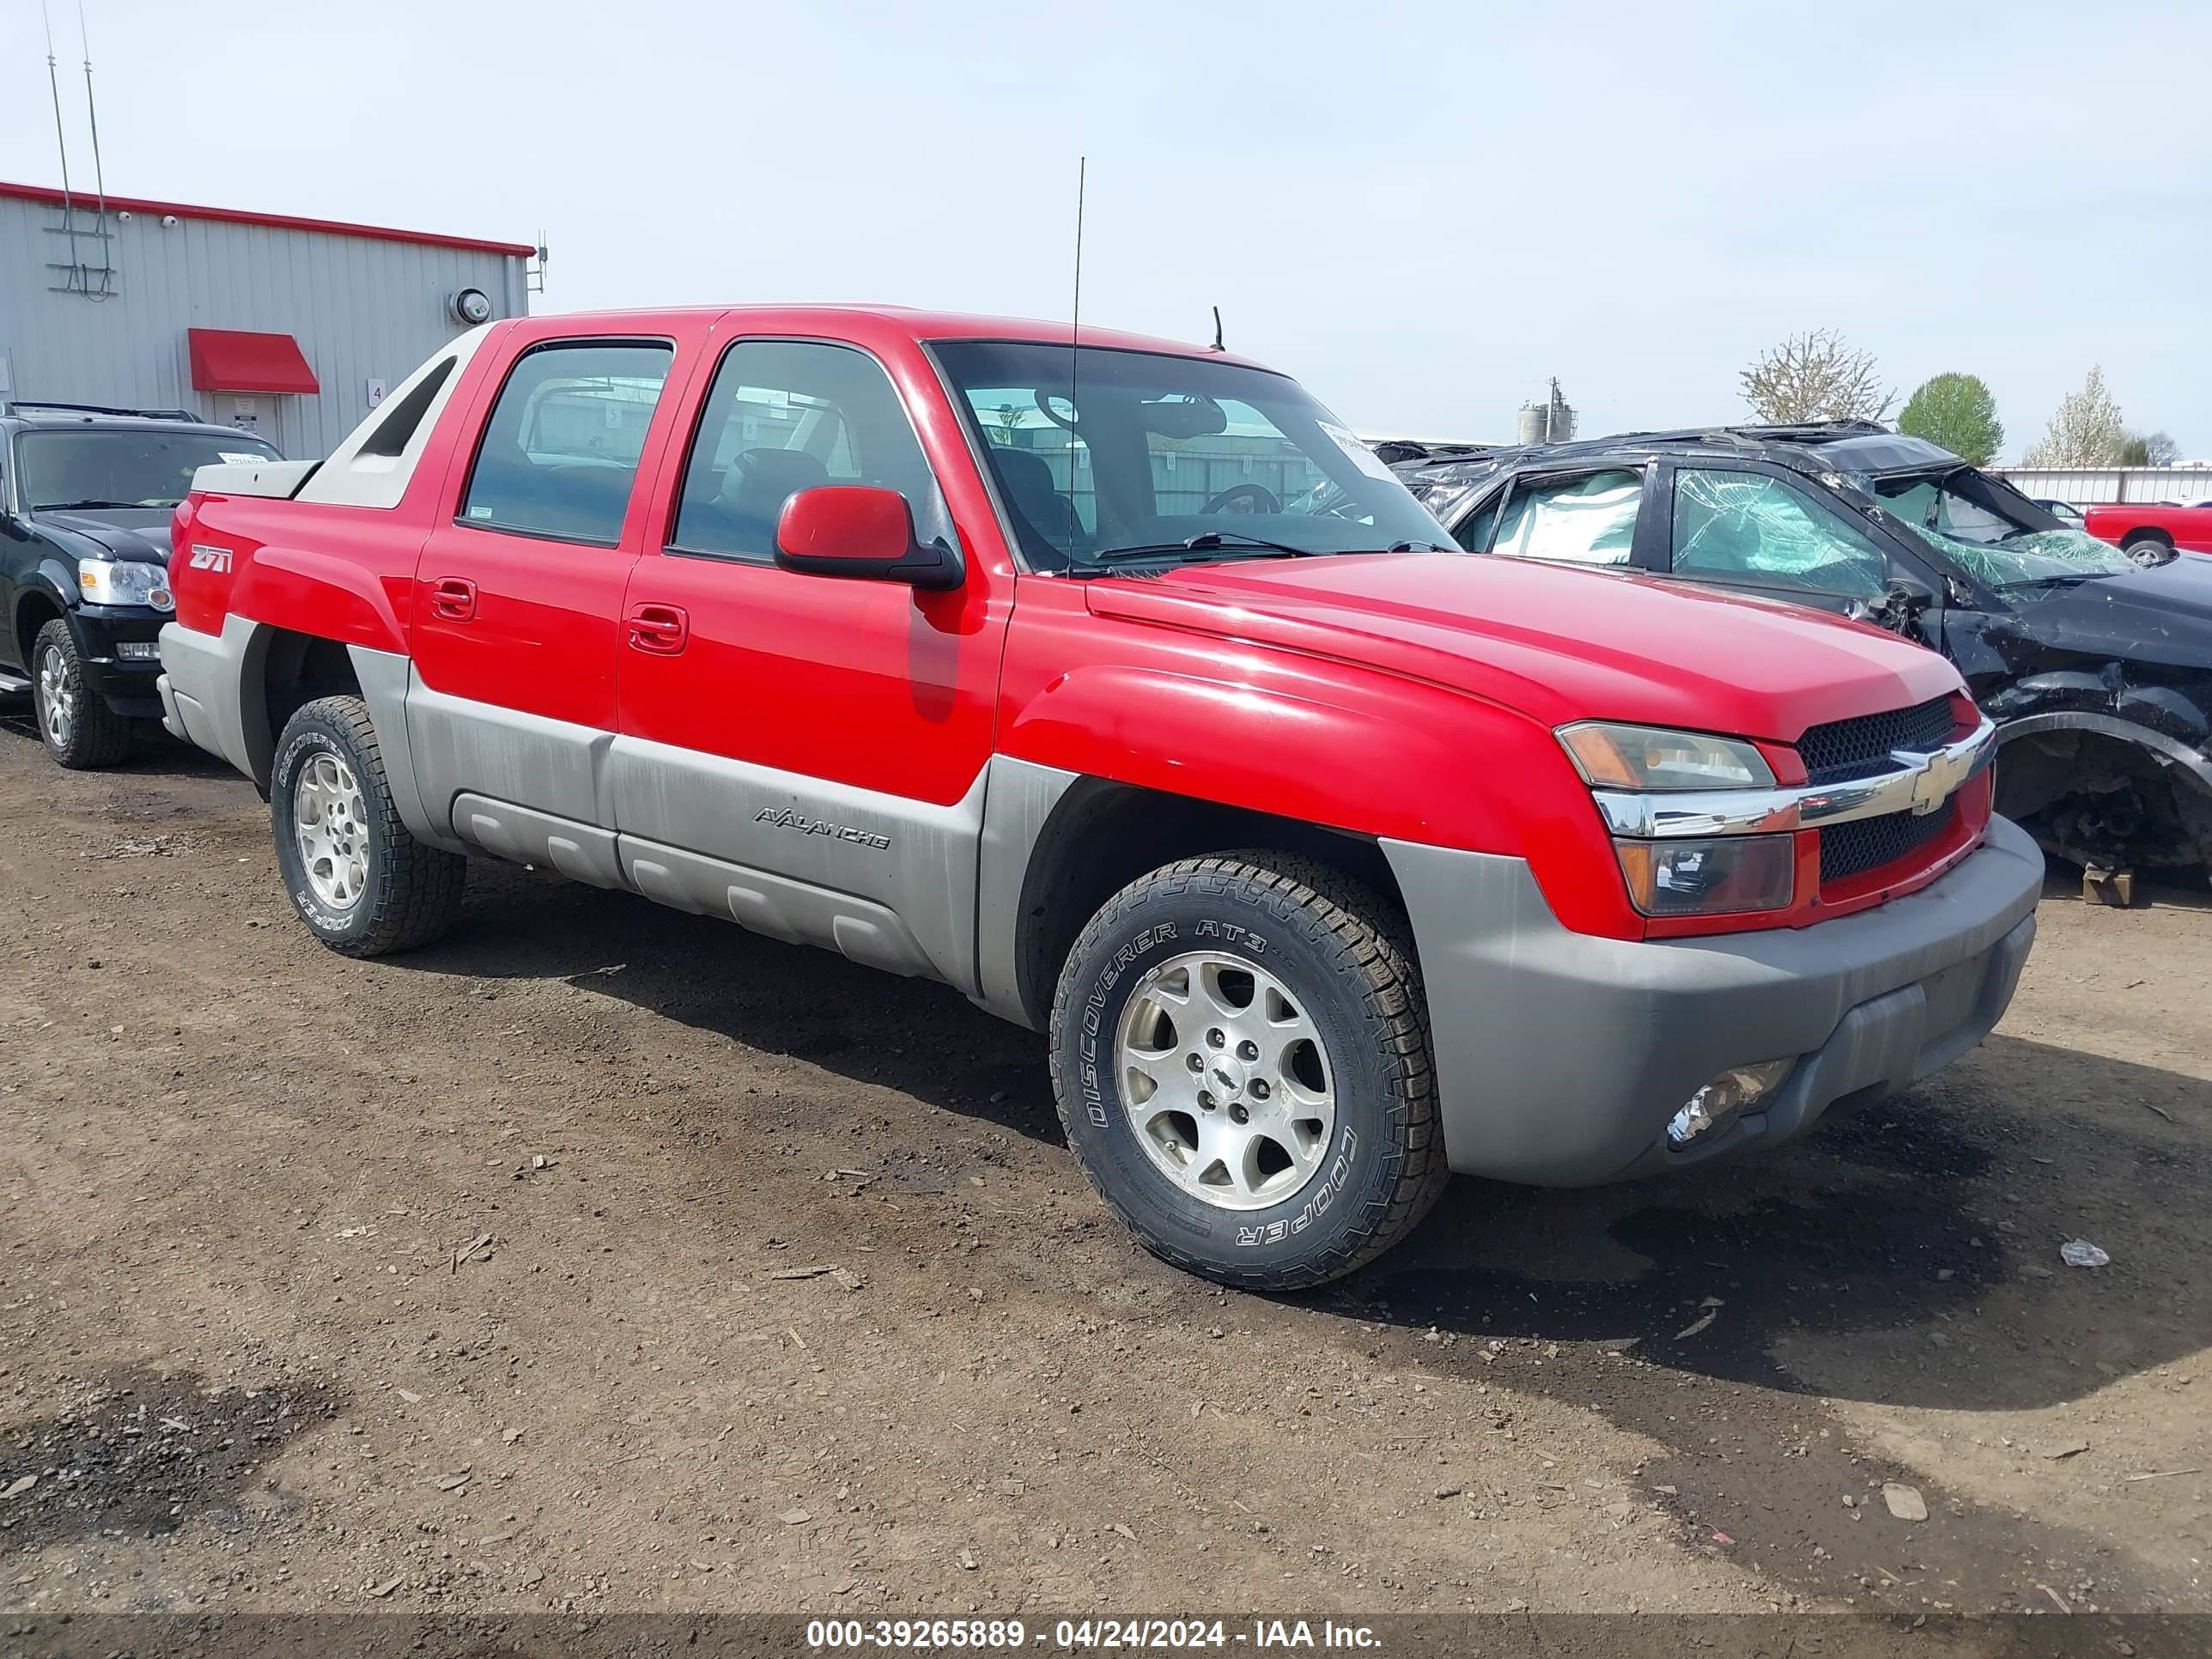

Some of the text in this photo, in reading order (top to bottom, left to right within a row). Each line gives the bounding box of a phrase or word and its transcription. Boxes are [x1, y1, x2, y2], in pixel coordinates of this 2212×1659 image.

[374, 386, 382, 399] 4
[611, 409, 617, 422] 5
[1081, 453, 1088, 462] 9
[190, 544, 233, 574] Z71
[277, 731, 347, 788] DISCOVERER
[752, 806, 891, 850] AVALANCHE
[295, 890, 354, 931] COOPER
[1079, 920, 1179, 1130] DISCOVERER
[1194, 919, 1267, 954] AT3
[1234, 1126, 1359, 1249] COOPER
